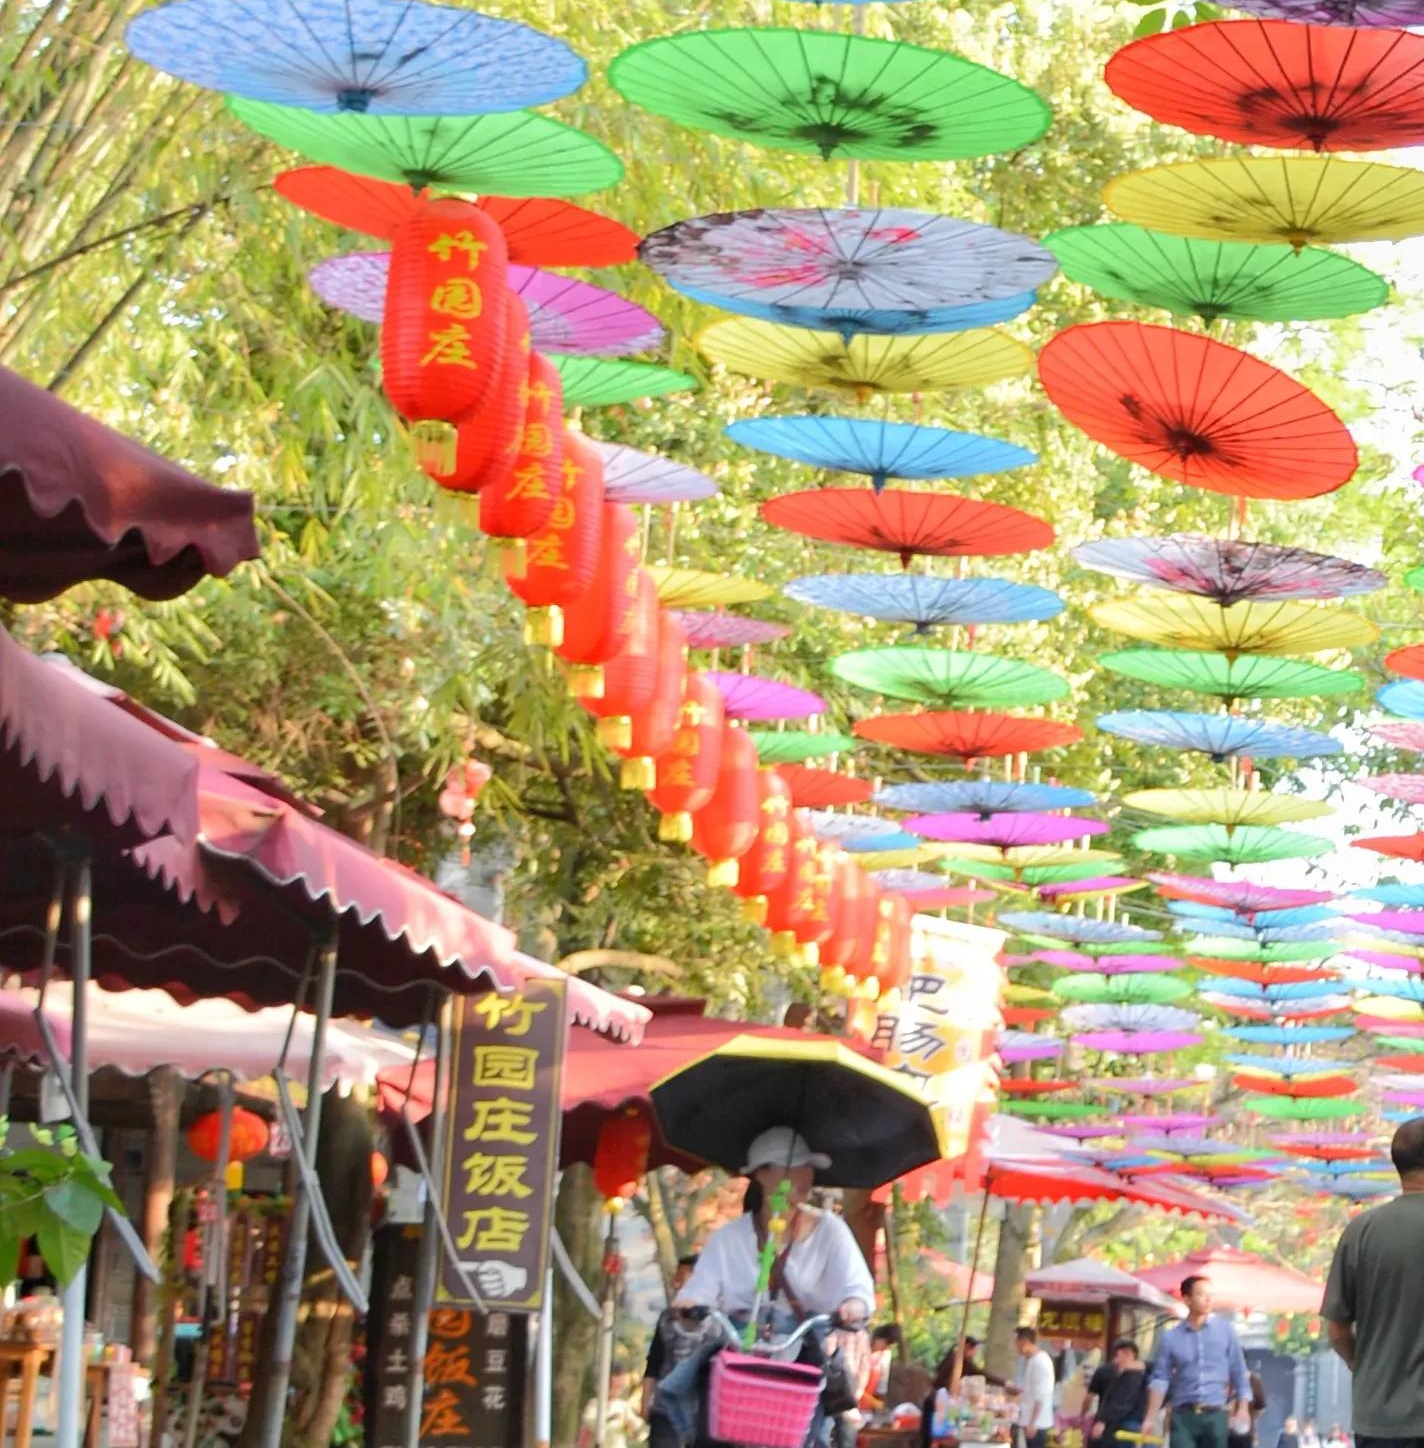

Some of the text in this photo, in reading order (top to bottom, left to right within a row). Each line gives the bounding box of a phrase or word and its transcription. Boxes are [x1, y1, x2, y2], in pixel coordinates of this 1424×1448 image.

[419, 230, 488, 370] 竹园庄
[455, 990, 548, 1253] 竹园庄饭店
